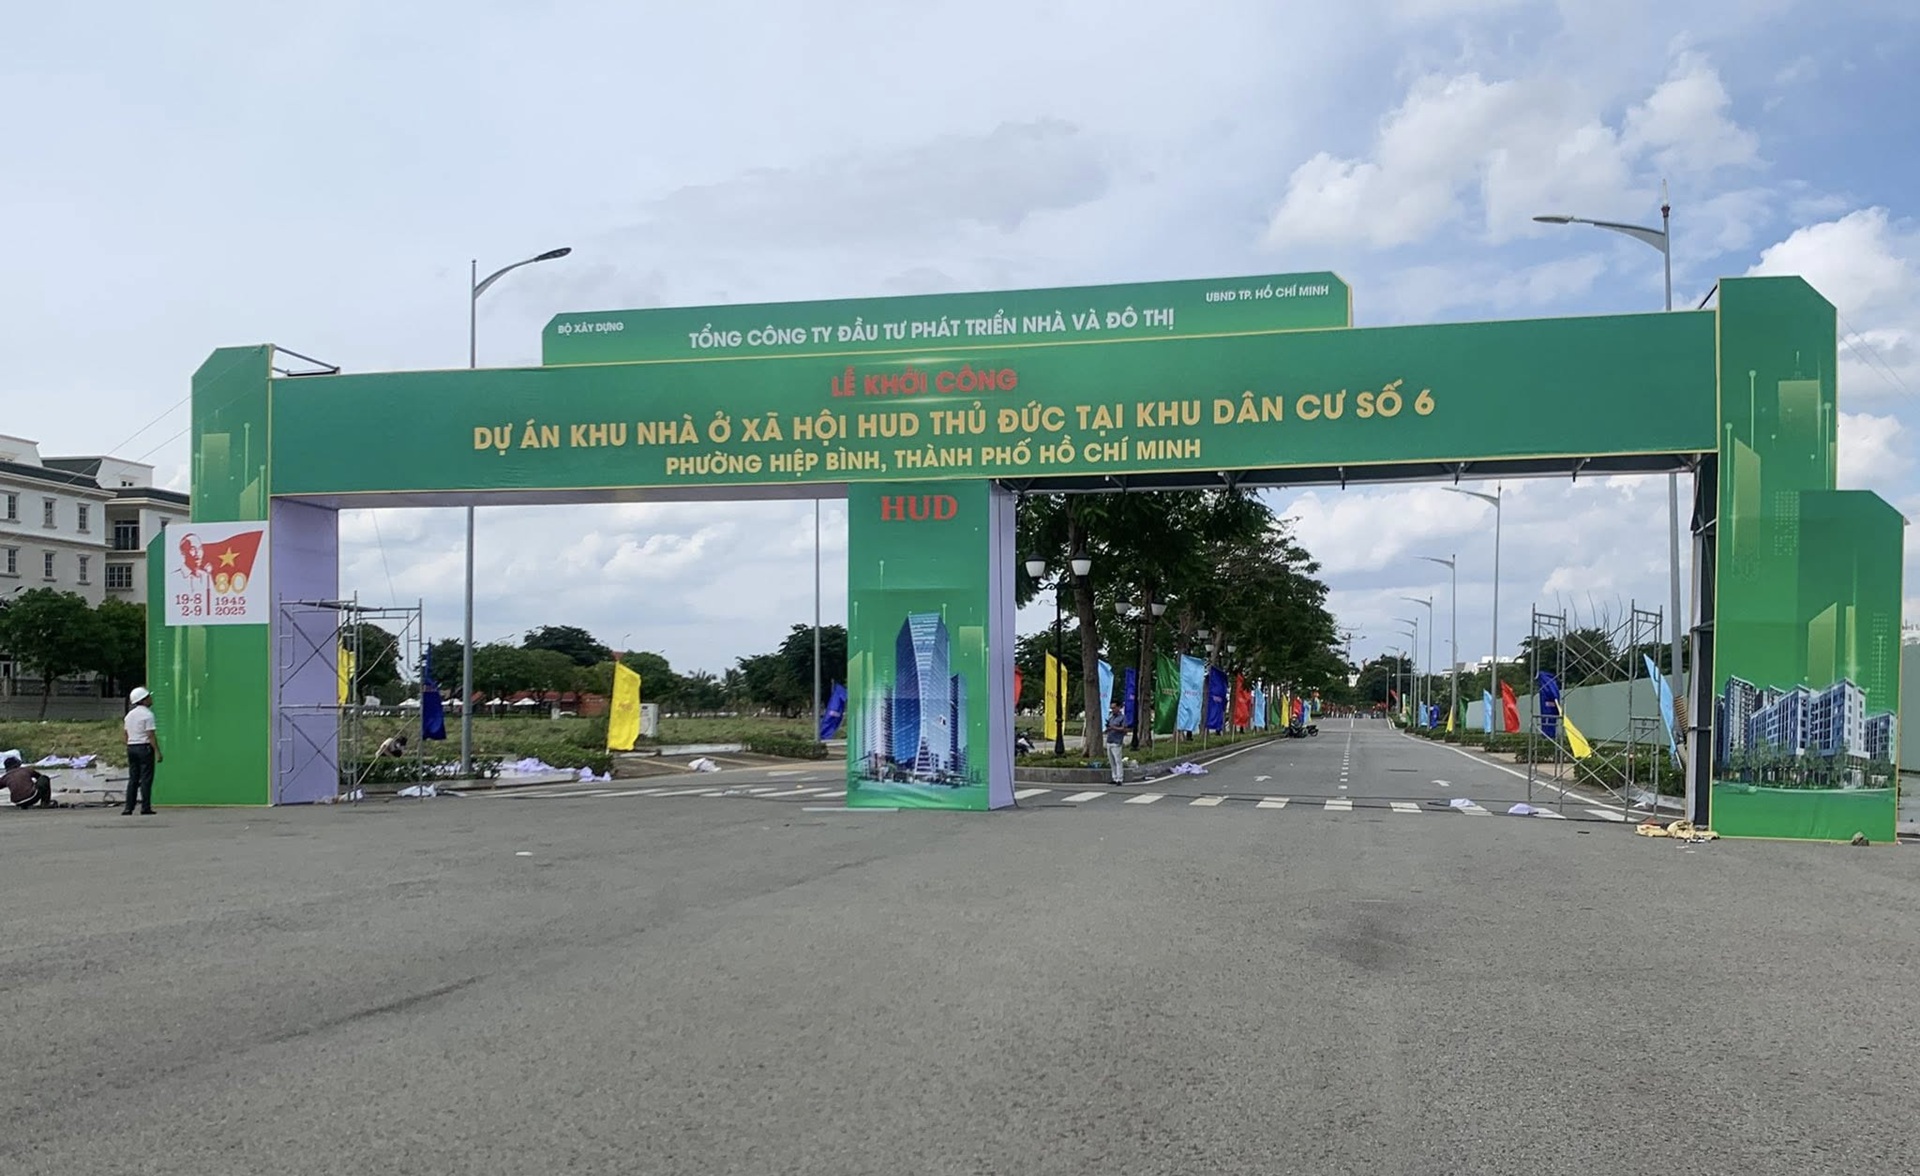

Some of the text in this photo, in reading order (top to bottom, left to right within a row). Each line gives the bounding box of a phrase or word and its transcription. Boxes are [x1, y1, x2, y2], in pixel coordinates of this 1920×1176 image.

[1206, 291, 1236, 302] UBND
[1239, 290, 1252, 299] TP.
[1275, 285, 1296, 297] CHÍ
[1299, 285, 1328, 296] MINH
[558, 322, 624, 335] BỘ XÂY DỰNG
[689, 306, 1173, 348] TỔNG CÔNG TY ĐẦU TƯ PHÁT TRIỂN NHÀ VÀ ĐÔ THỊ
[832, 365, 1017, 397] LỄ KHỞI CÔNG
[474, 379, 1434, 455] DỰ ÁN KHU NHÀ Ở XÃ HỘI HUD THỦ ĐỨC TẠI KHU DÂN CƯ SỐ 6
[667, 434, 1200, 476] PHƯỜNG HIỆP BÌNH, THÀNH PHỐ HỒ CHÍ MINH
[880, 494, 958, 521] HUD
[215, 572, 247, 594] 80
[176, 593, 202, 604] 19-8
[215, 596, 246, 605] 1945
[181, 606, 202, 616] 2-9
[215, 607, 246, 615] 2025
